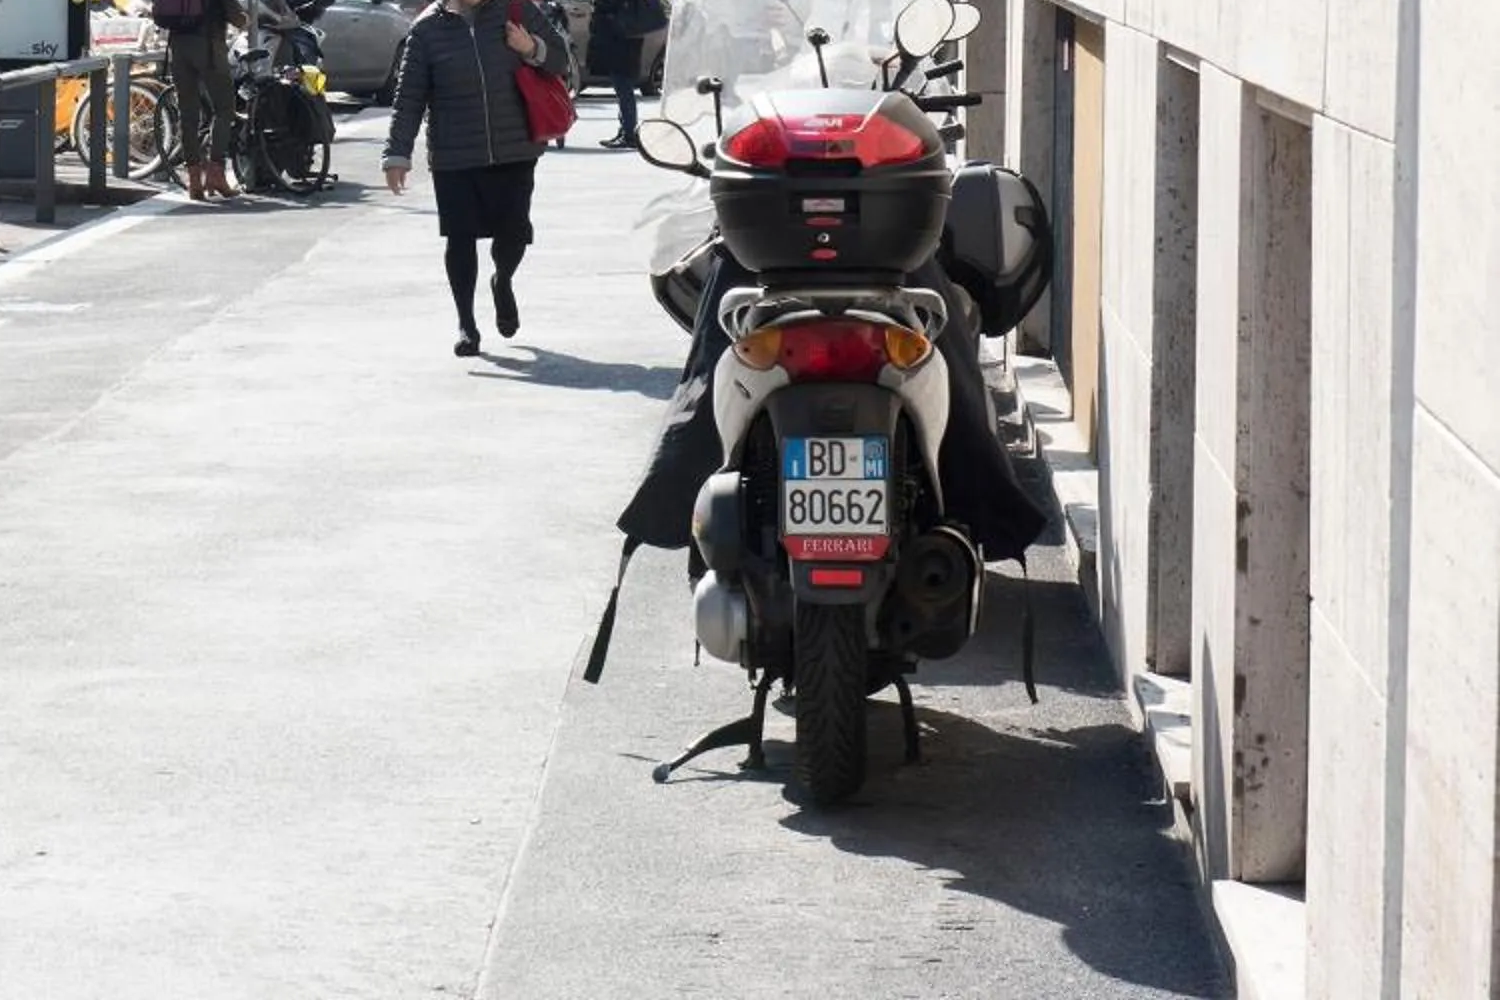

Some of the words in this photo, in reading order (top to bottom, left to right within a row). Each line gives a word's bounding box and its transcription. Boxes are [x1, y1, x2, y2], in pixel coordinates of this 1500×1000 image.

[32, 40, 59, 58] sky
[809, 441, 846, 476] BD
[866, 458, 884, 477] MI
[789, 489, 885, 525] 80662
[803, 539, 874, 553] FERRARI
